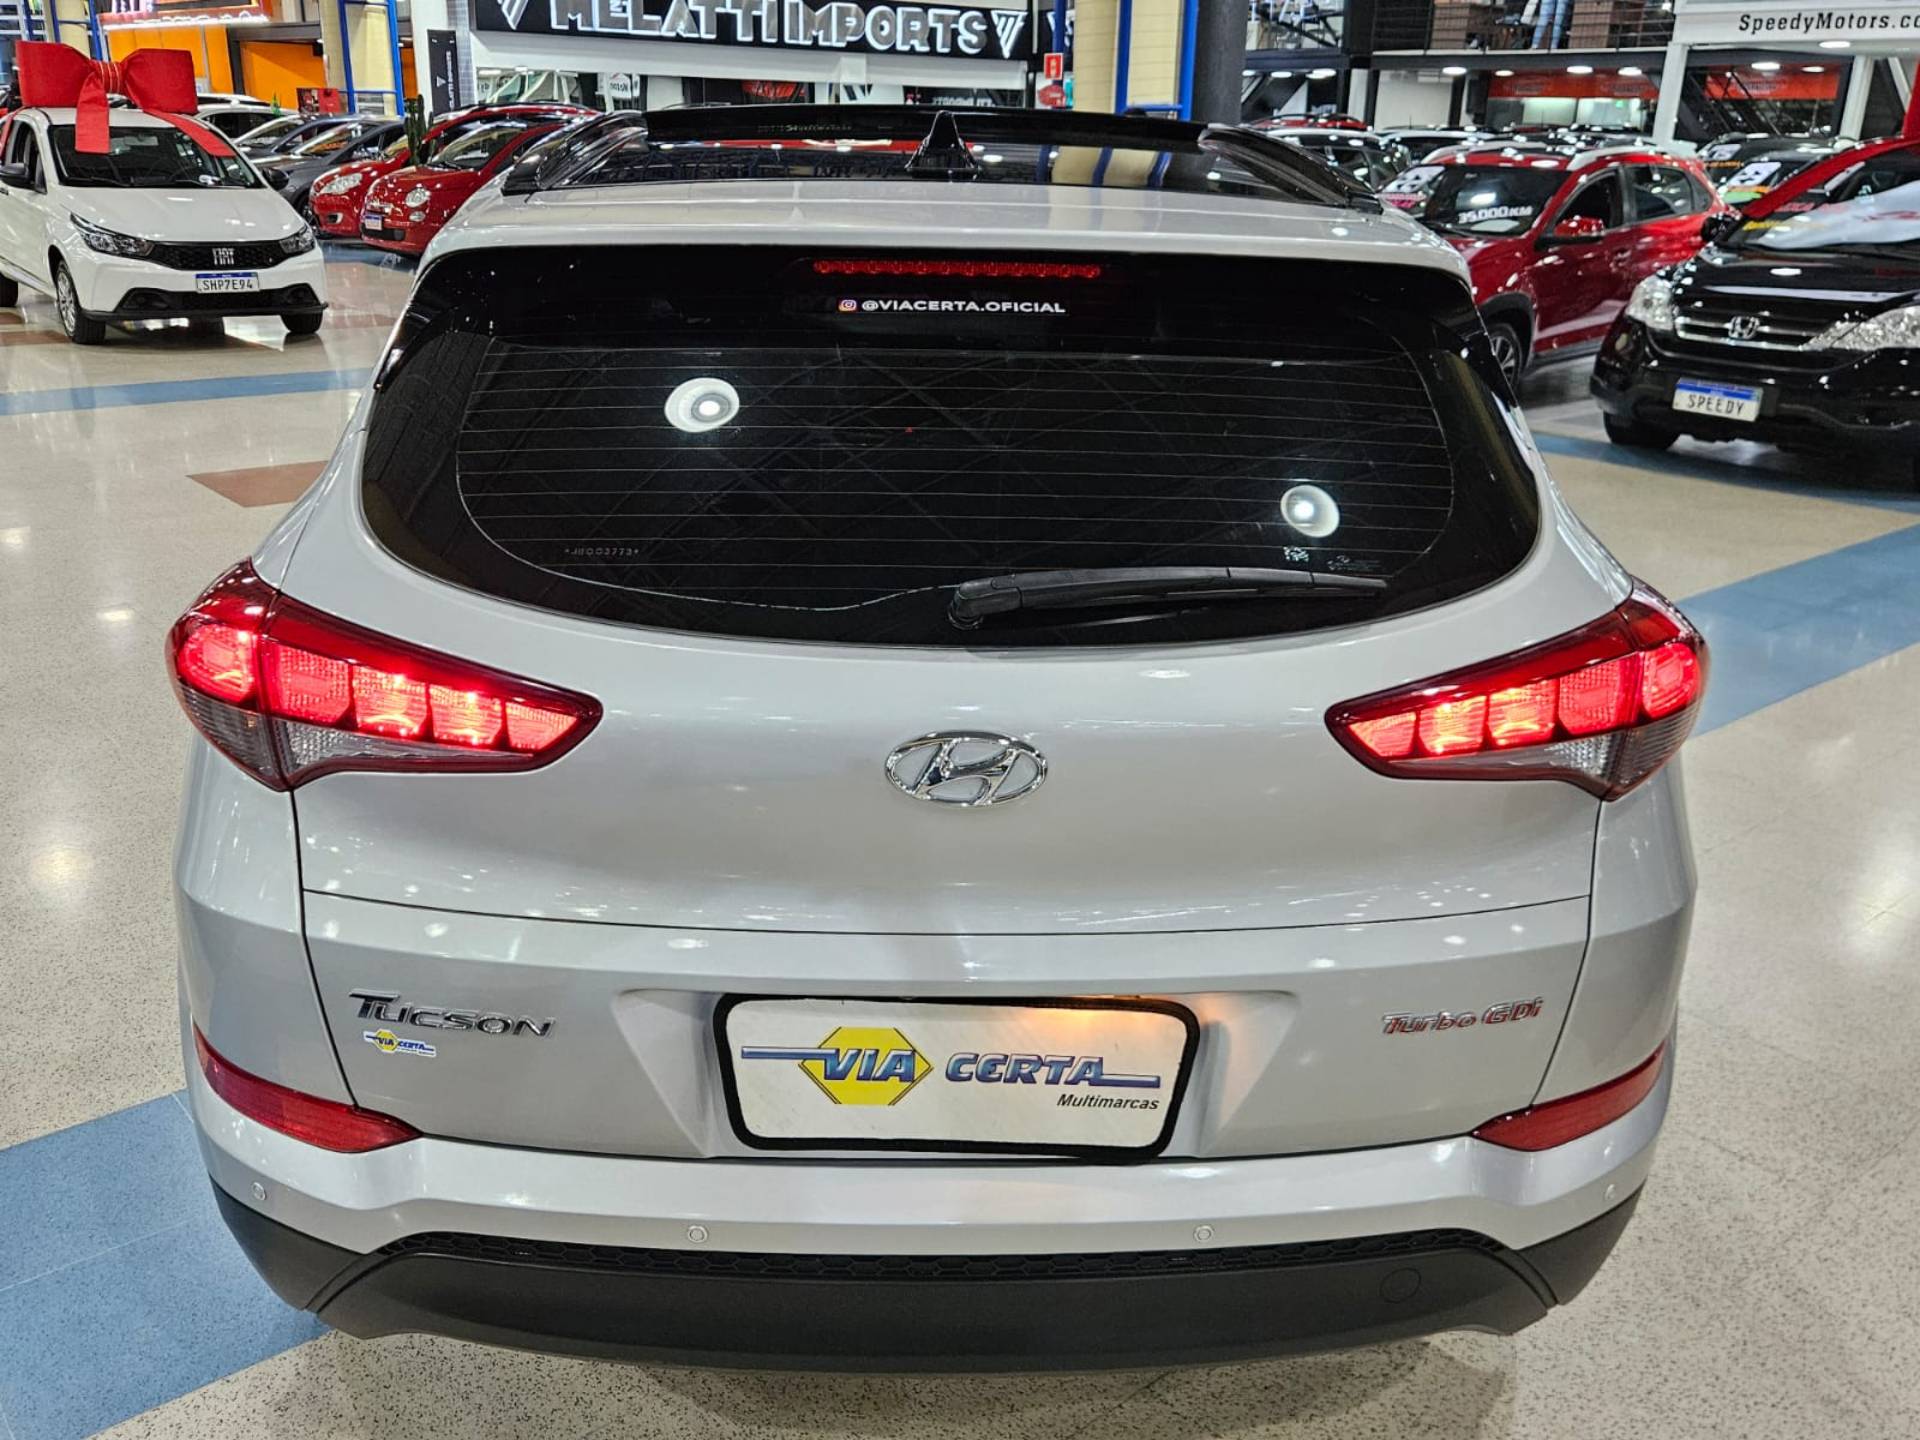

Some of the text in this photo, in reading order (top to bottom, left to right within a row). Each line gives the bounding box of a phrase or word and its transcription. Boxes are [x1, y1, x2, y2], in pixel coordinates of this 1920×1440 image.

[550, 0, 987, 54] MELATTI IMPORTS
[203, 279, 253, 291] SHP7E94
[862, 300, 1066, 313] @VIACERTA.OFICIAL
[1687, 394, 1745, 415] SPEEDY
[1382, 1011, 1477, 1035] Turbo
[821, 1048, 1105, 1087] VIA CERTA
[1057, 1093, 1159, 1111] Multimarcas
